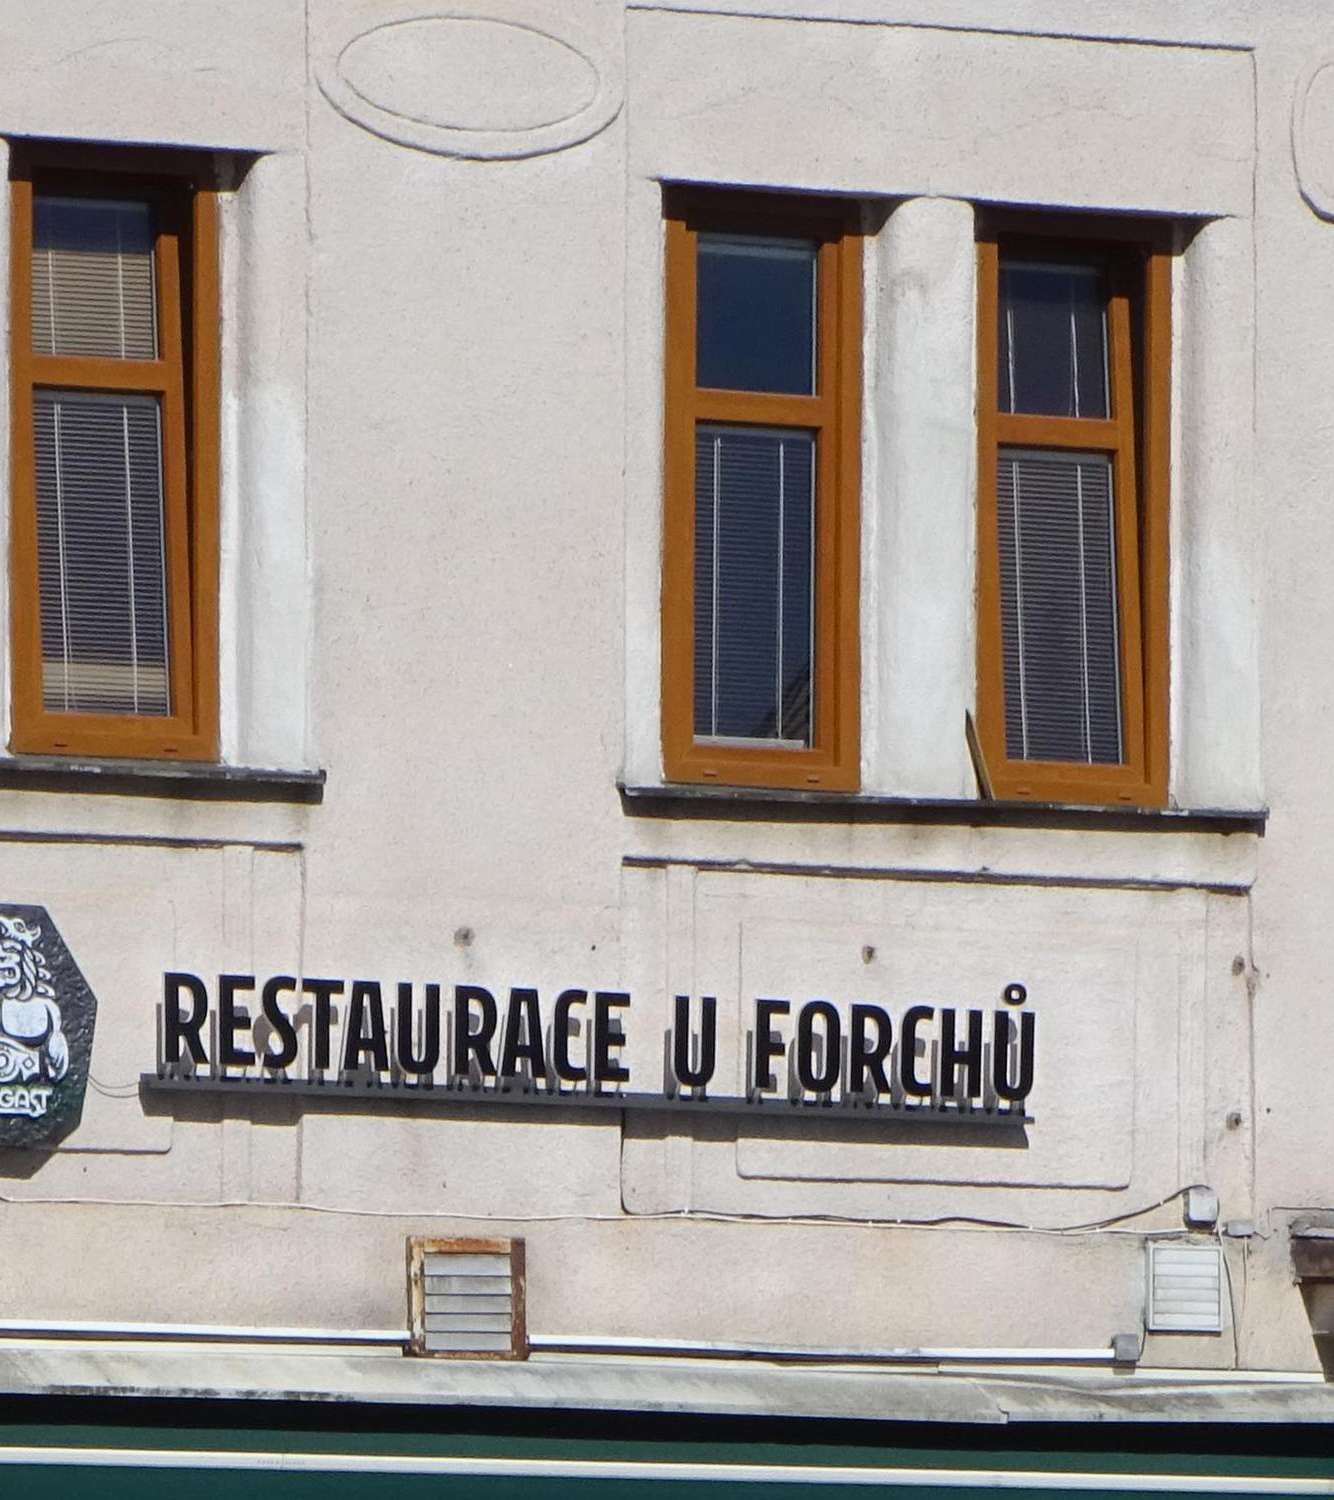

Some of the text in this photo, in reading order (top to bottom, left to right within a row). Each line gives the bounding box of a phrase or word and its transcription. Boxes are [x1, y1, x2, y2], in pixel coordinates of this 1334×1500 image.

[163, 971, 1037, 1101] RESTAURACE U FORCHŮ
